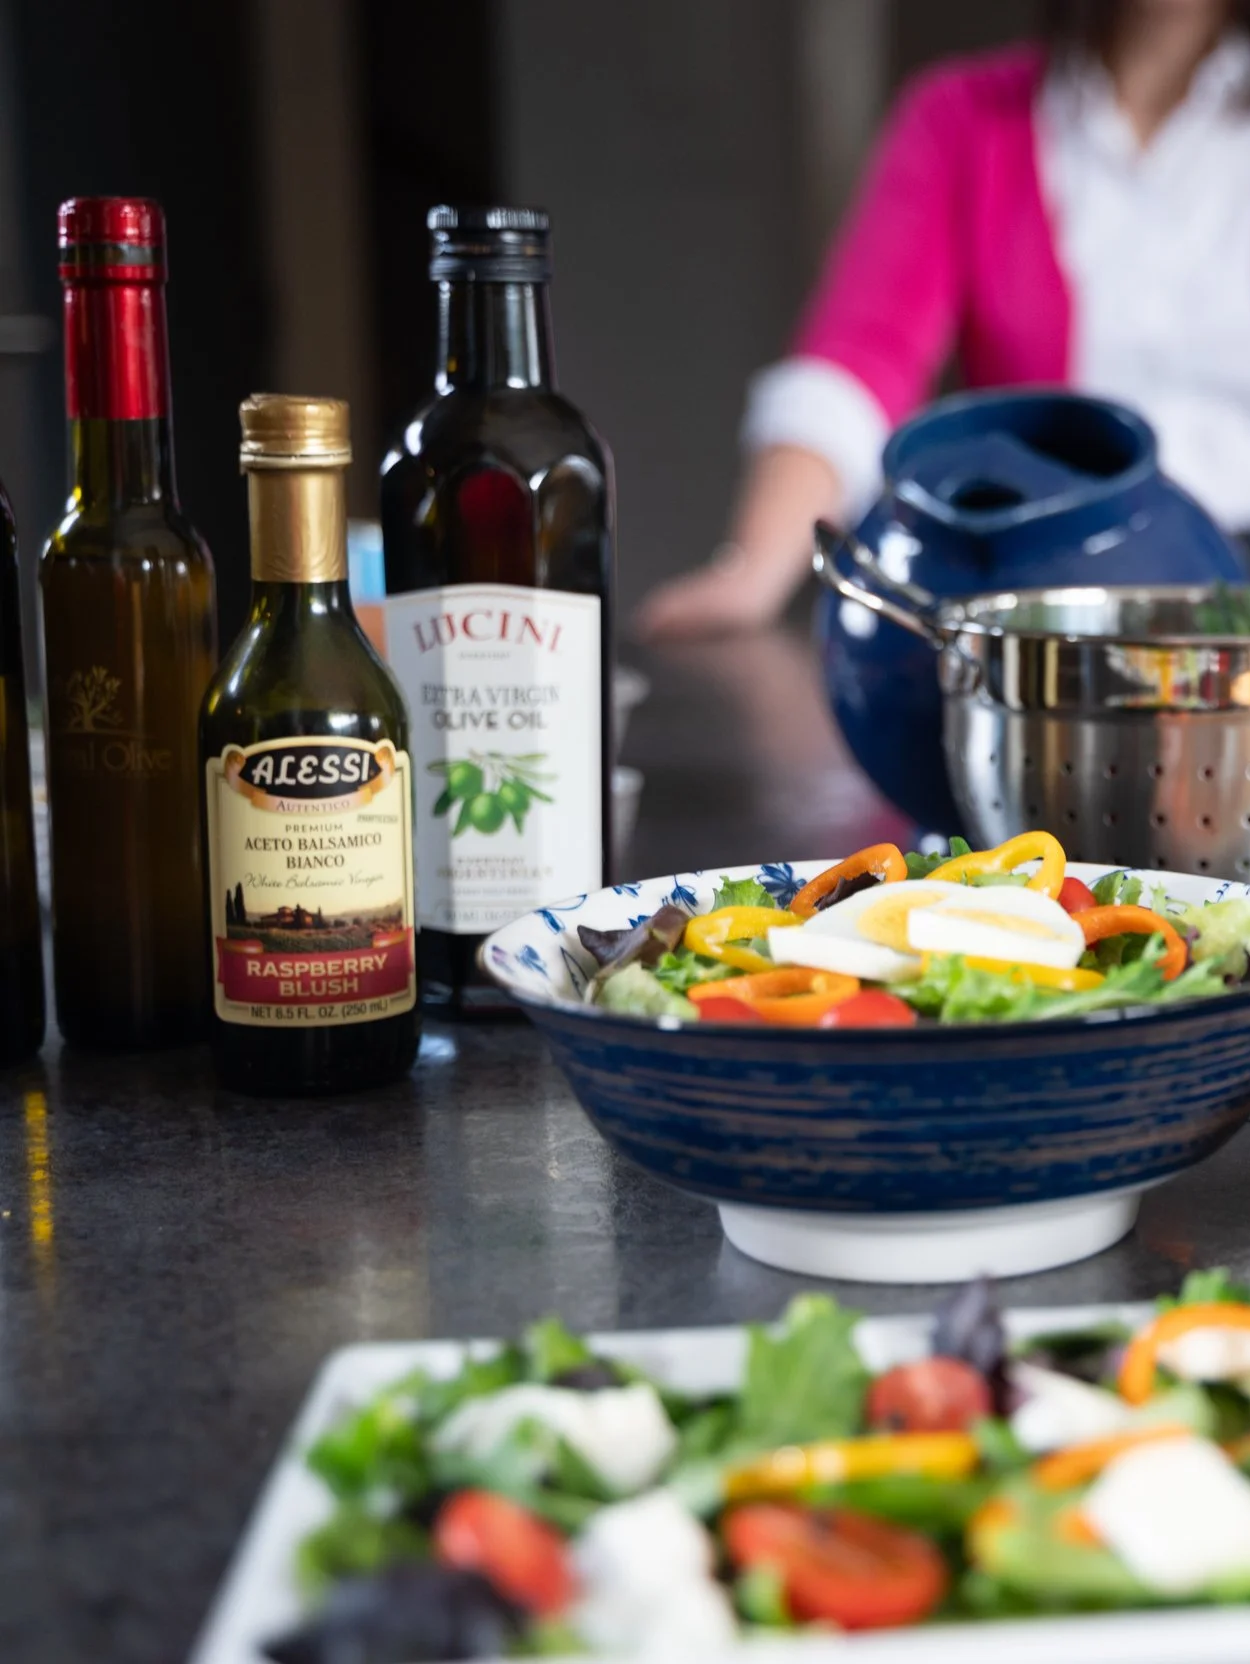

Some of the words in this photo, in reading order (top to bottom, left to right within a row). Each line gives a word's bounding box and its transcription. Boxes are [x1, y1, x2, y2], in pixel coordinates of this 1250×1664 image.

[413, 608, 564, 653] LUCINI
[430, 709, 501, 731] OLIVE
[507, 709, 549, 731] OIL
[251, 752, 371, 786] ALESSI
[285, 823, 344, 834] PREMIUM
[245, 836, 292, 851] ACETO
[298, 832, 382, 850] BALSAMICO
[286, 855, 345, 869] BIANCO
[246, 953, 388, 978] RASPBERRY
[279, 977, 360, 997] BLUSH
[251, 1005, 271, 1019] NET
